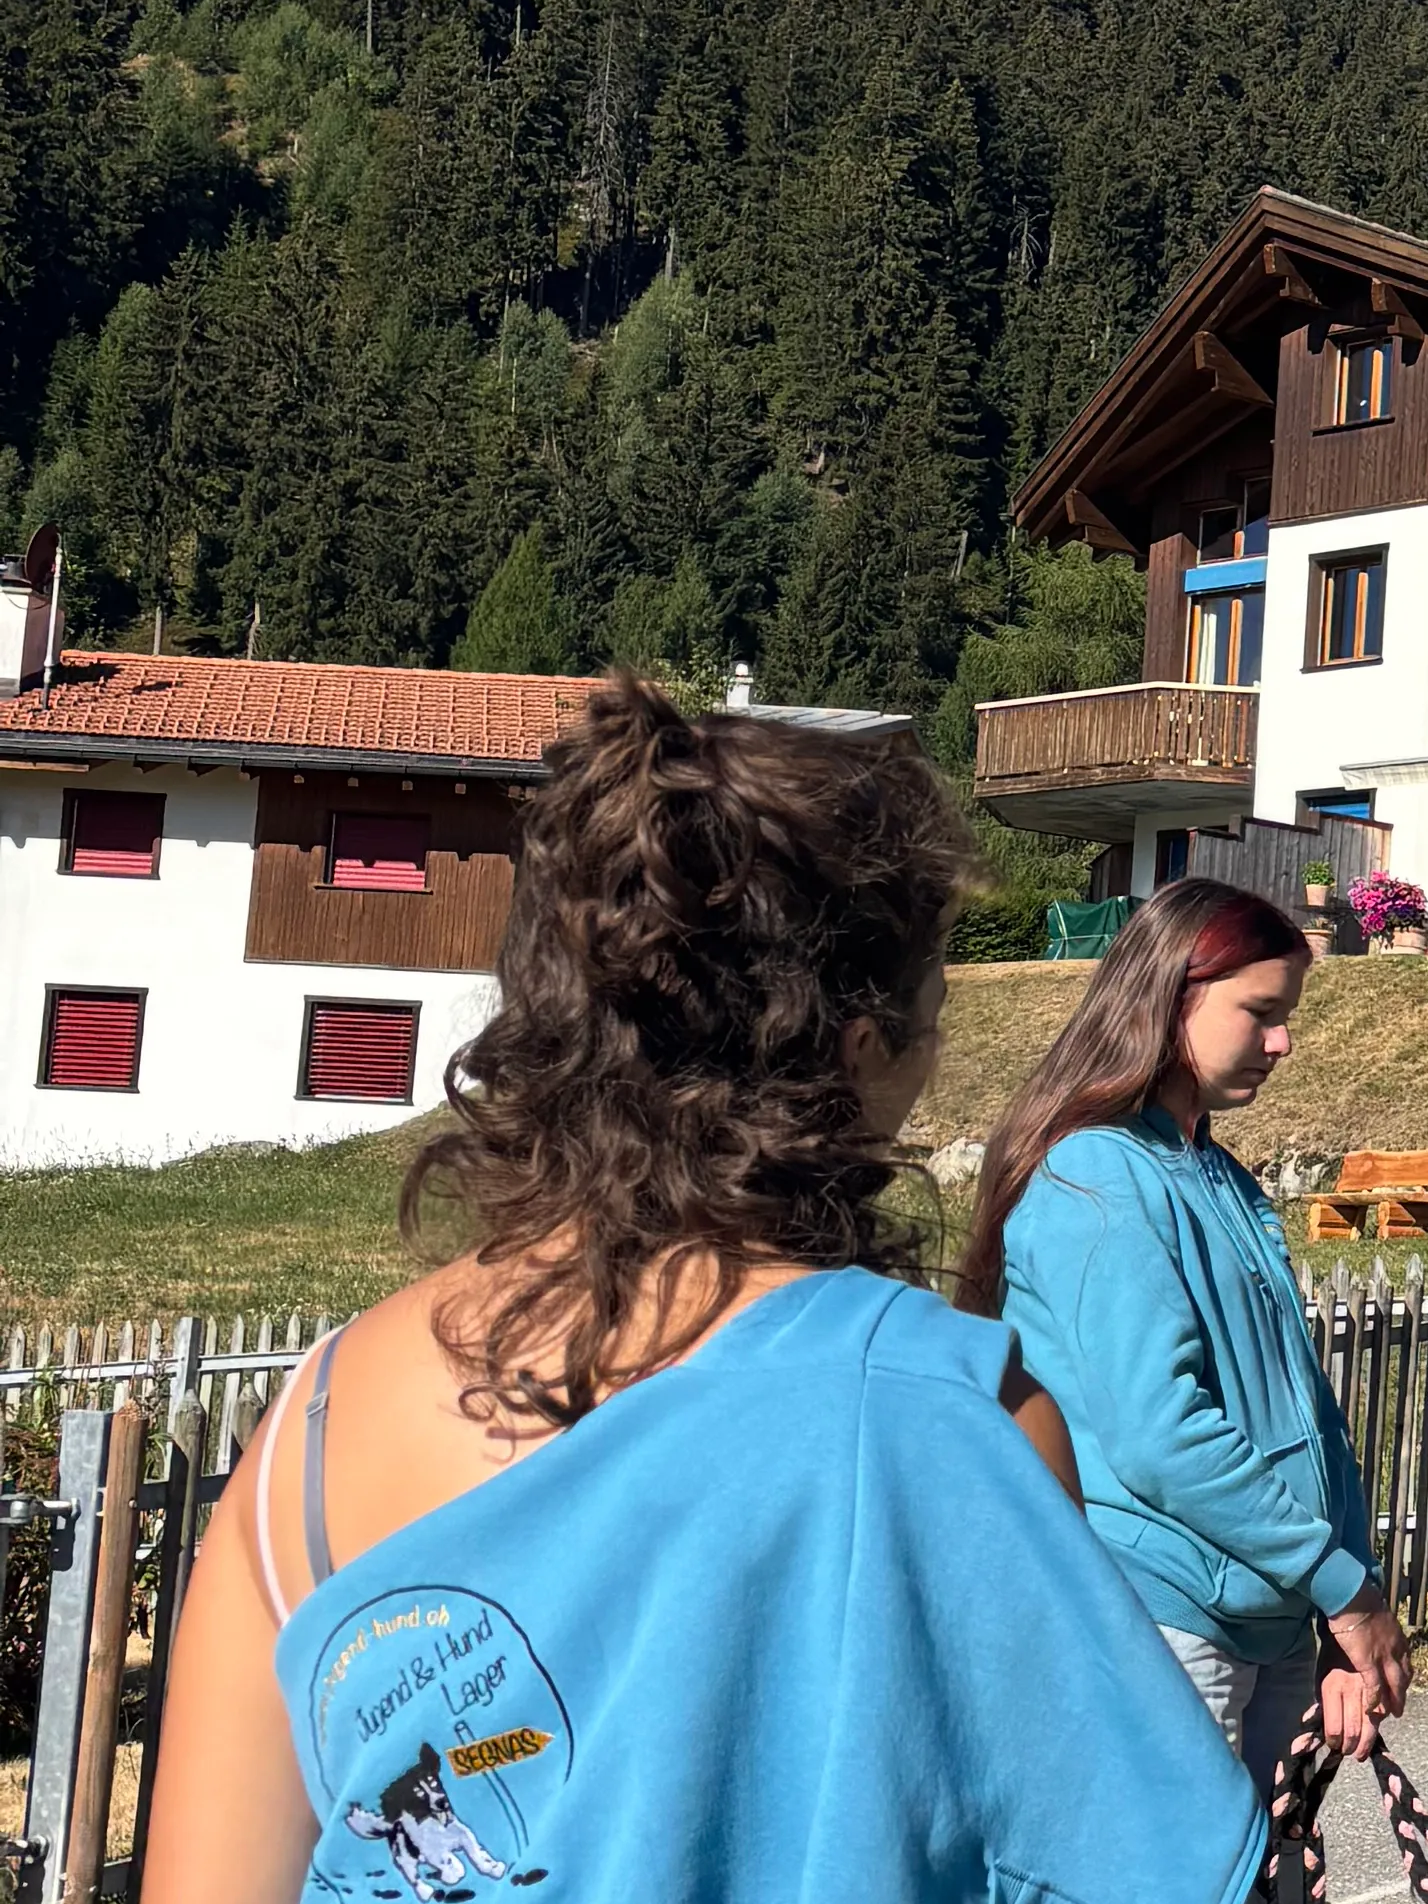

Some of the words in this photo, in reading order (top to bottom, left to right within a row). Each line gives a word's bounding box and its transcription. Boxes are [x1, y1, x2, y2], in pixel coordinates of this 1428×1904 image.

[355, 1669, 413, 1743] Jugend
[410, 1656, 436, 1690] &
[434, 1608, 494, 1672] Hund
[440, 1655, 507, 1716] Lager
[454, 1727, 540, 1776] SEGNAS
